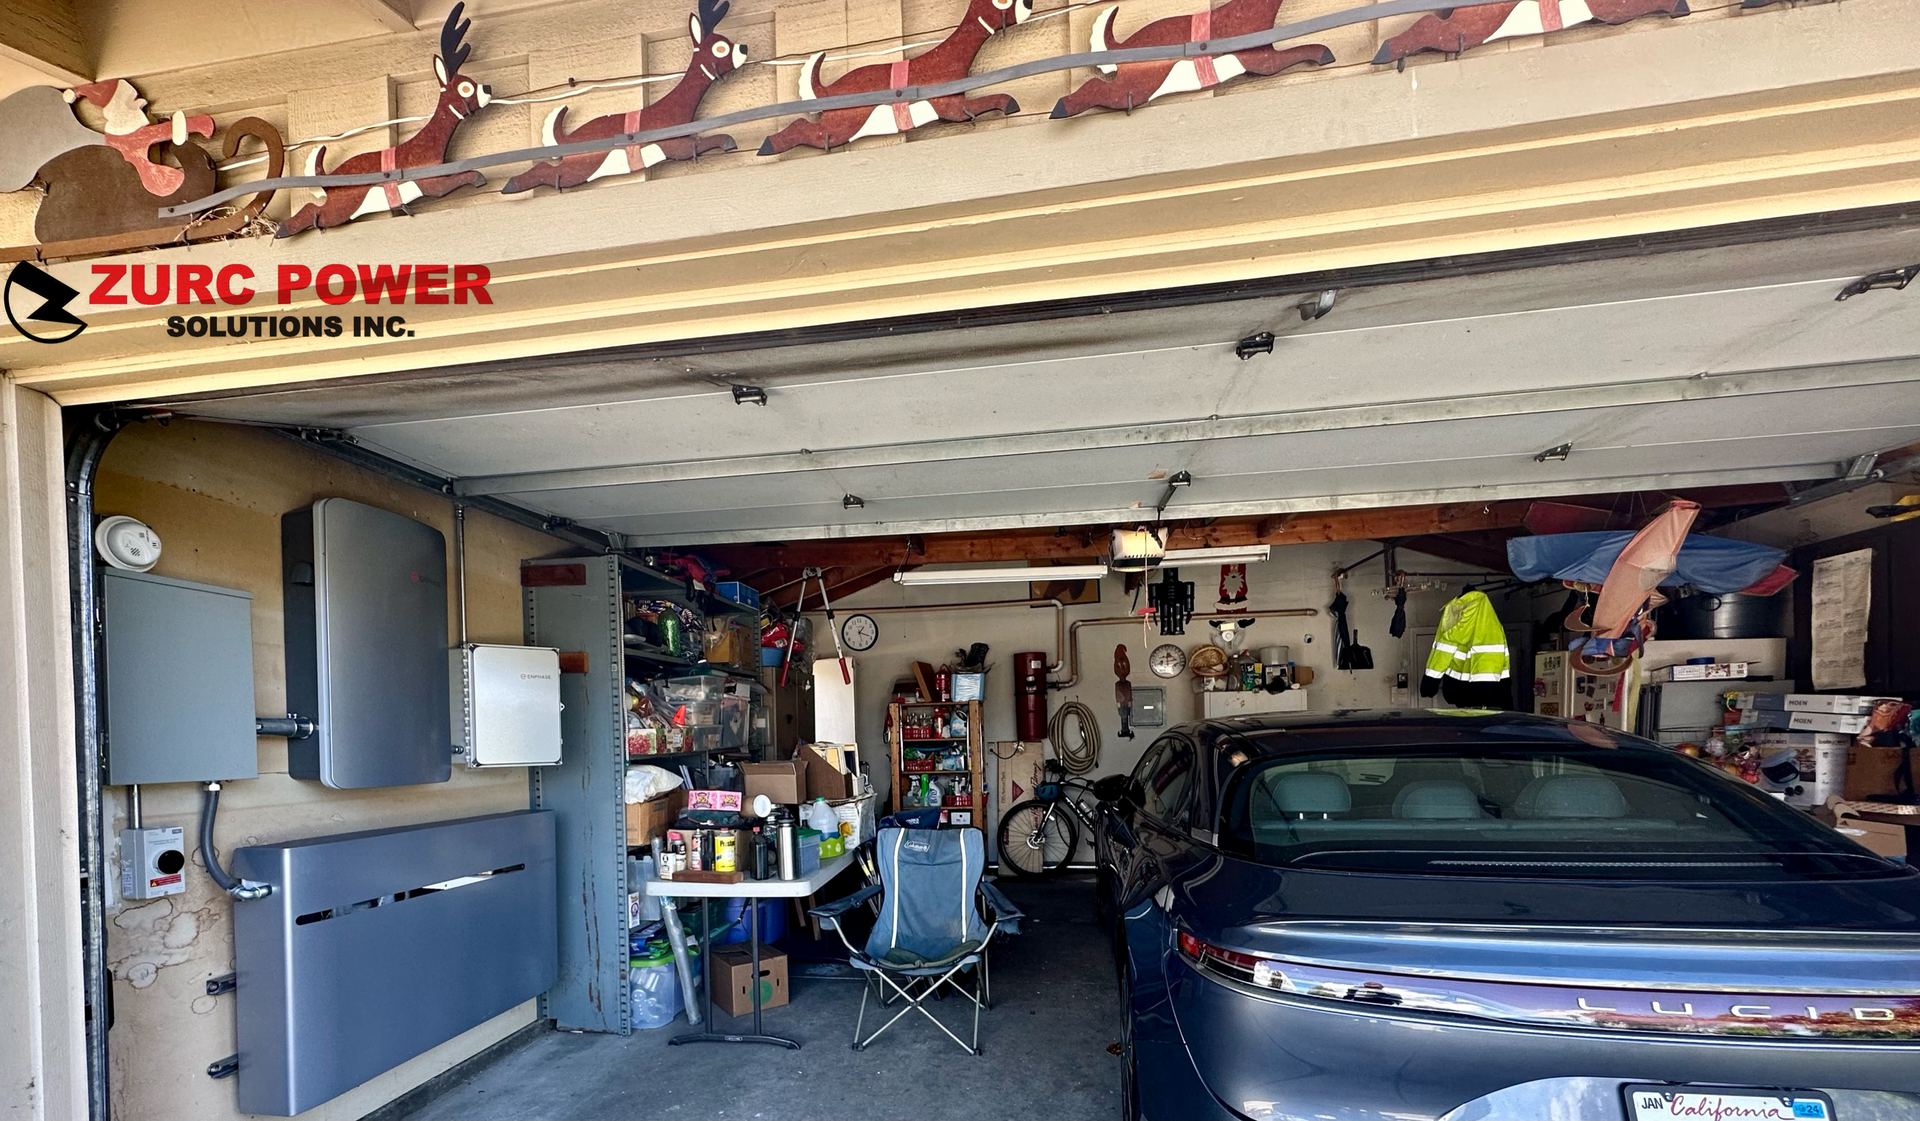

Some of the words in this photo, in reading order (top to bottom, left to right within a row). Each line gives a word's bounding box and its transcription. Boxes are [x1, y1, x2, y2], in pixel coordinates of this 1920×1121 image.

[1577, 997, 1894, 1021] LUCID
[1641, 1097, 1663, 1109] JAN
[1671, 1095, 1794, 1121] California
[1806, 1105, 1819, 1113] 24
